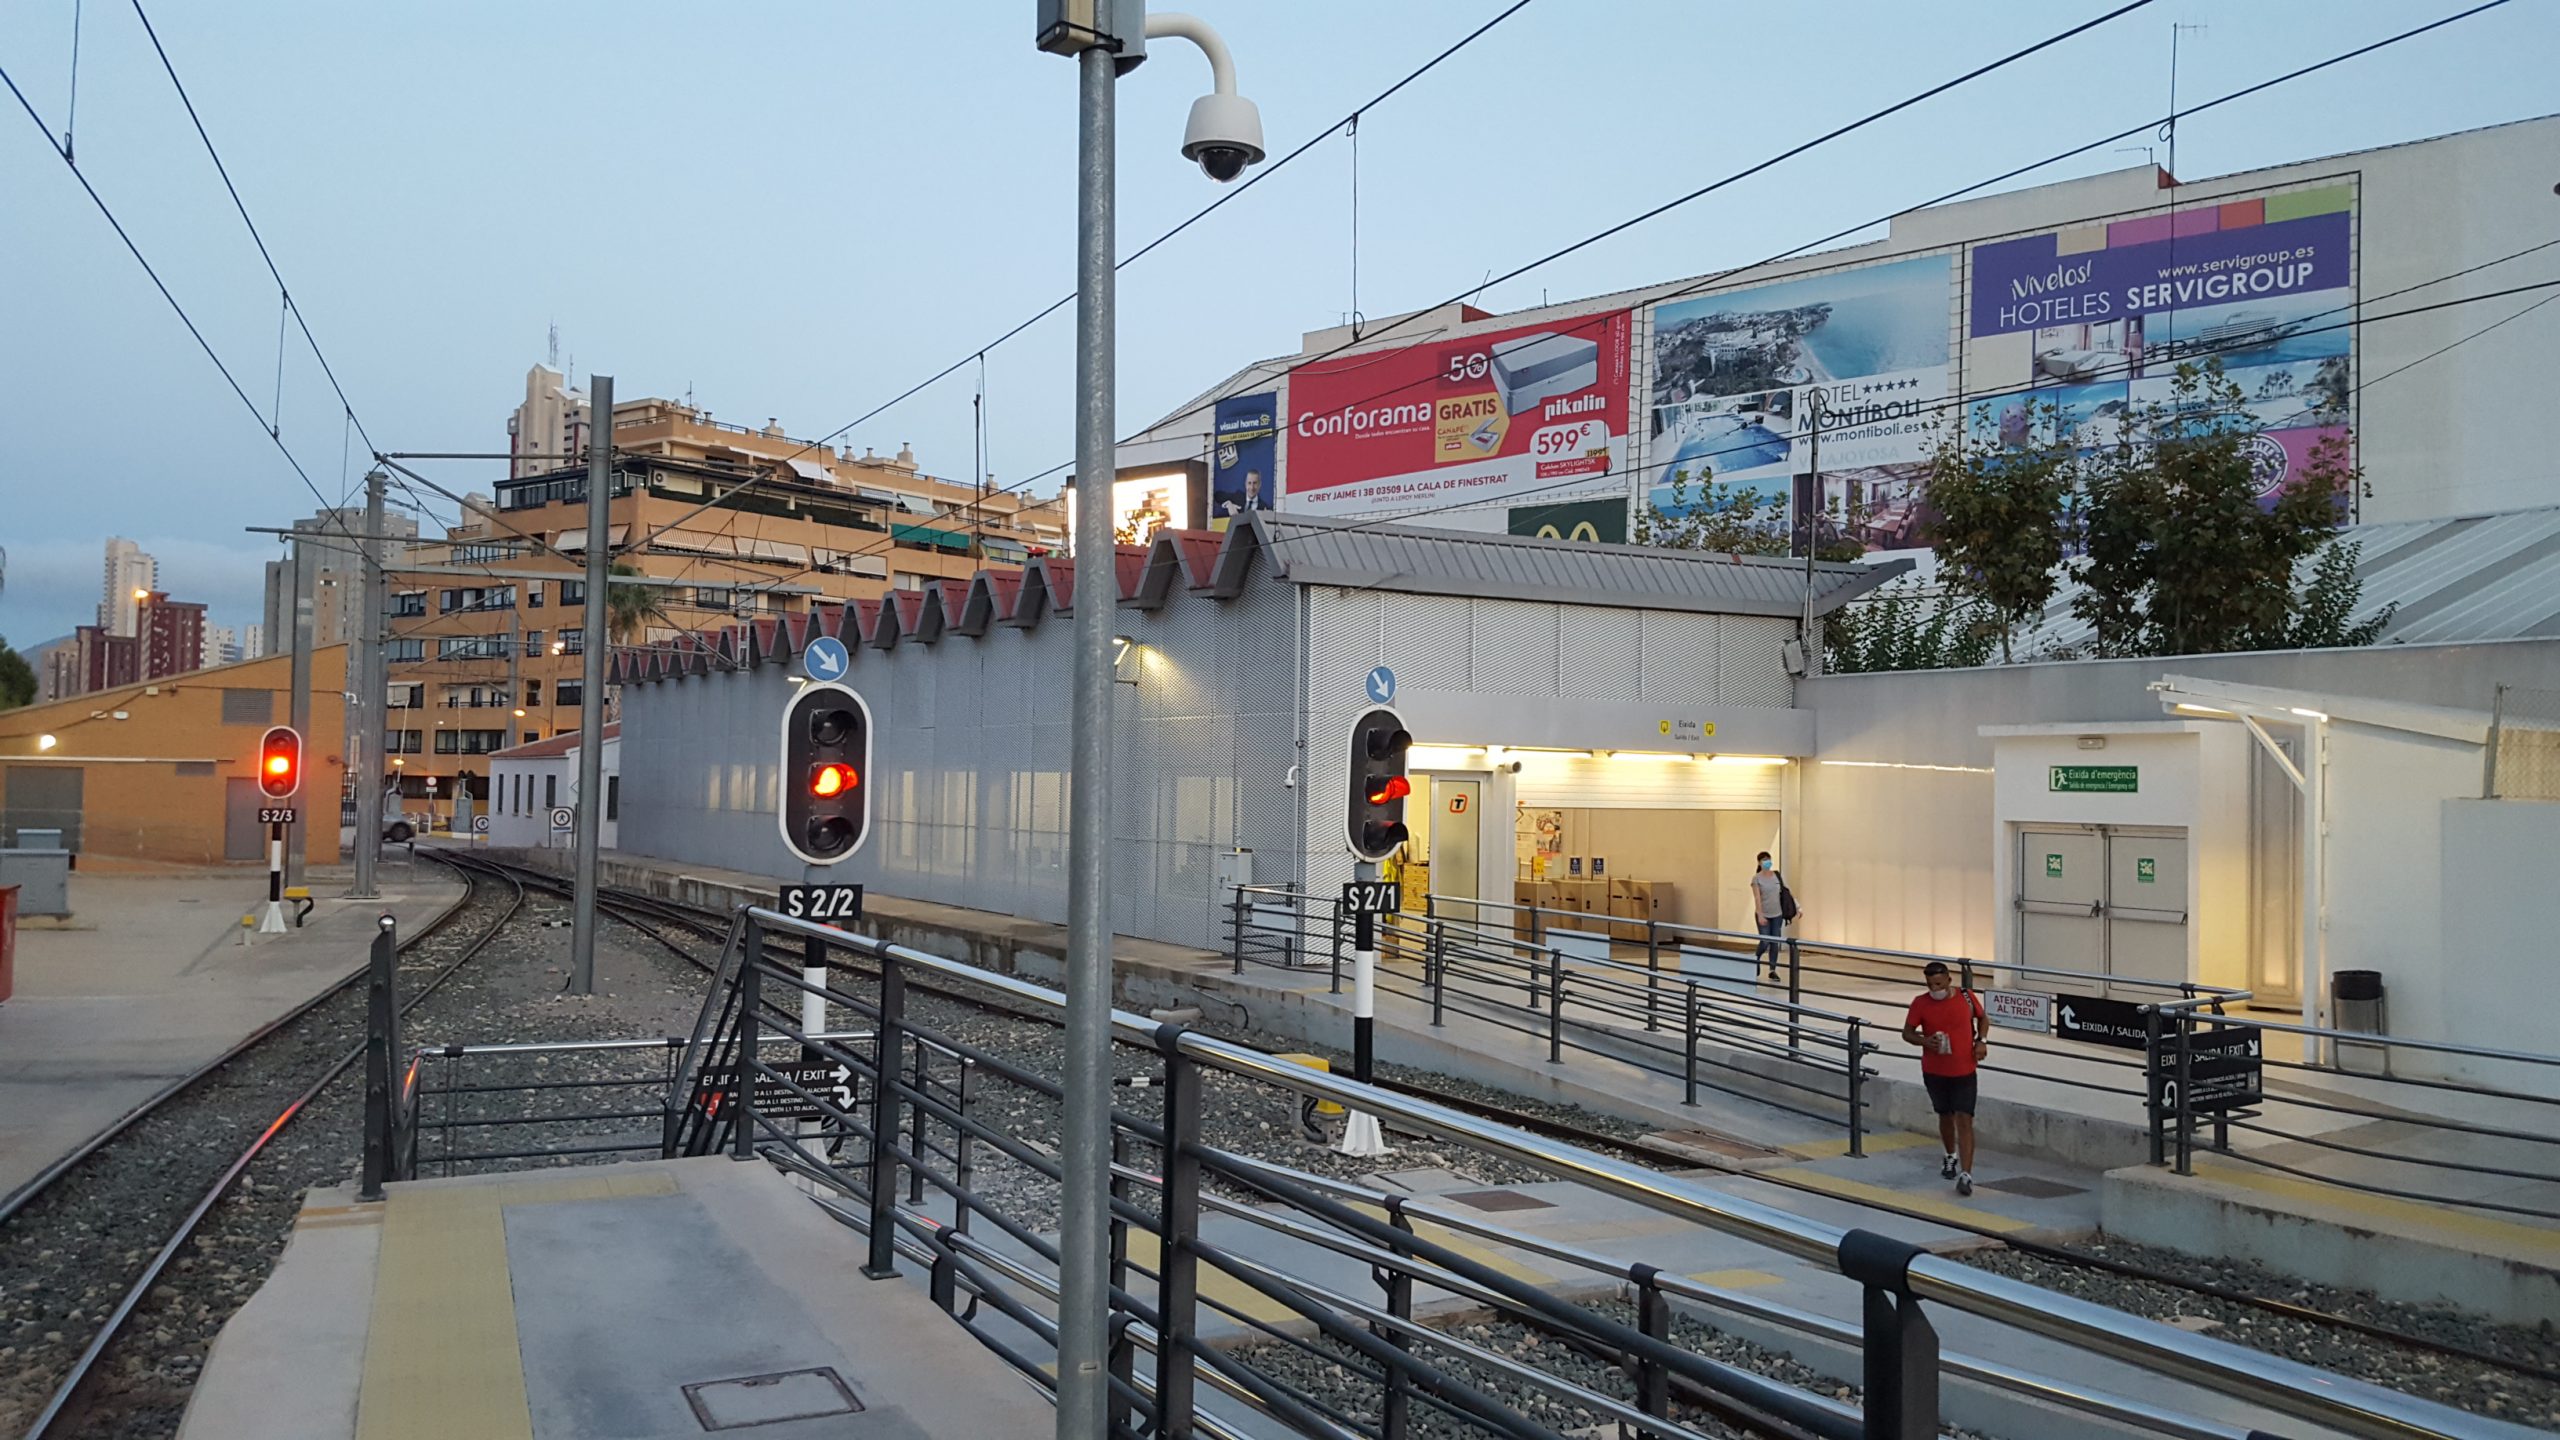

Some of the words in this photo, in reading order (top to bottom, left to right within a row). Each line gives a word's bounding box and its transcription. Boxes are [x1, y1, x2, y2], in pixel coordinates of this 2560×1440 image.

[2158, 246, 2315, 279] www.servigroup.es
[2000, 292, 2111, 328] HOTELES
[2126, 263, 2314, 310] SERVIGROUP
[1544, 394, 1606, 421] pikolin
[1799, 383, 1862, 409] HOTEL
[1297, 402, 1432, 438] Conforama
[1439, 398, 1498, 421] GRATIS
[1220, 419, 1240, 432] visual
[1240, 418, 1260, 429] home
[1798, 422, 1920, 446] ww.montiboli.es
[1307, 492, 1332, 503] C/REY
[1332, 489, 1357, 500] JAIME
[1376, 484, 1401, 496] 03509
[1403, 483, 1415, 493] LA
[1417, 481, 1441, 492] CALA
[1443, 479, 1456, 489] DE
[1457, 473, 1509, 488] FINESTRAT
[2068, 768, 2089, 779] Eixida
[261, 809, 271, 822] S
[271, 809, 293, 822] 2/3
[788, 888, 804, 918] S
[810, 887, 855, 917] 2/2
[1348, 886, 1360, 911] S
[1364, 884, 1396, 911] 2/1
[1996, 1004, 2009, 1014] AL
[2010, 1005, 2036, 1017] TREN
[2081, 1020, 2109, 1034] EIXIDA
[2116, 1026, 2148, 1040] SALIDA
[2160, 1053, 2177, 1067] EIXI
[802, 1069, 828, 1081] EXIT
